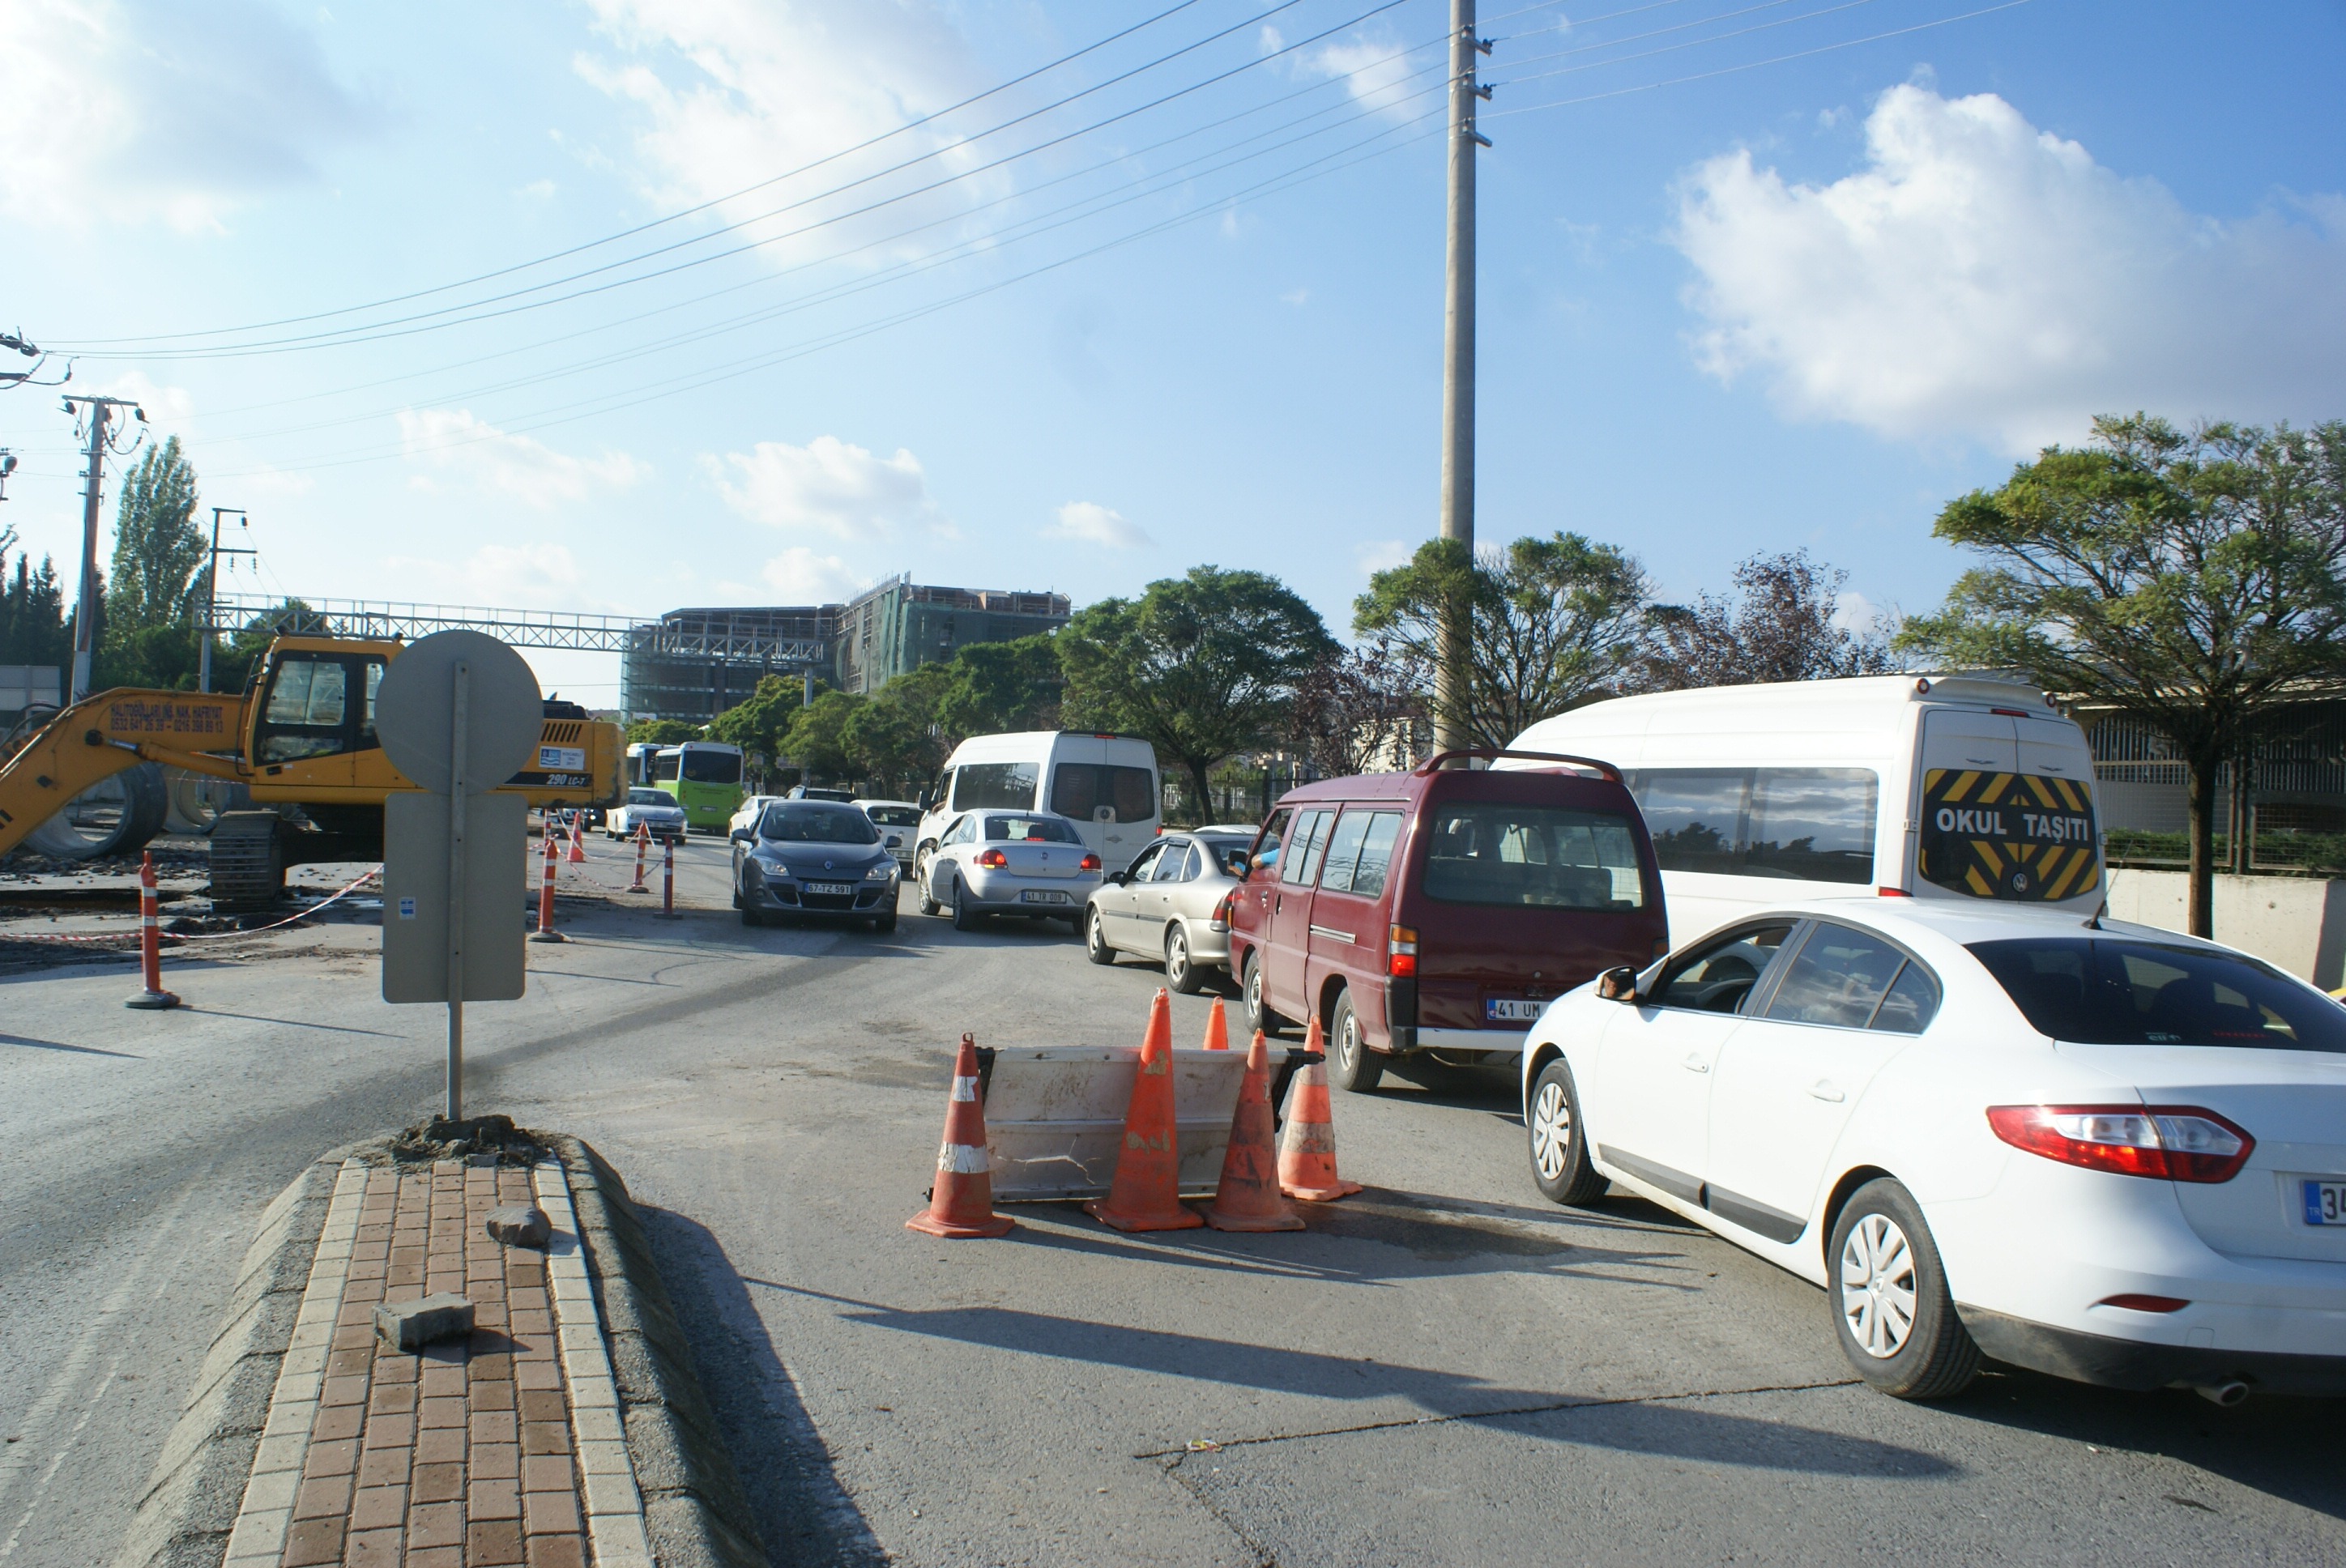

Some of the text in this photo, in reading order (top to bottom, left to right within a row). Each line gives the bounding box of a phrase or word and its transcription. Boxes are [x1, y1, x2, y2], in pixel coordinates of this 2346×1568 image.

[111, 718, 128, 731] 0532
[174, 718, 190, 732] 0216
[546, 773, 567, 785] 290
[1936, 807, 2088, 843] OKUL TAŞITI
[835, 885, 850, 893] 591
[1039, 893, 1047, 901] TR
[1498, 1002, 1540, 1017] 41 UM
[2307, 1207, 2321, 1216] TR
